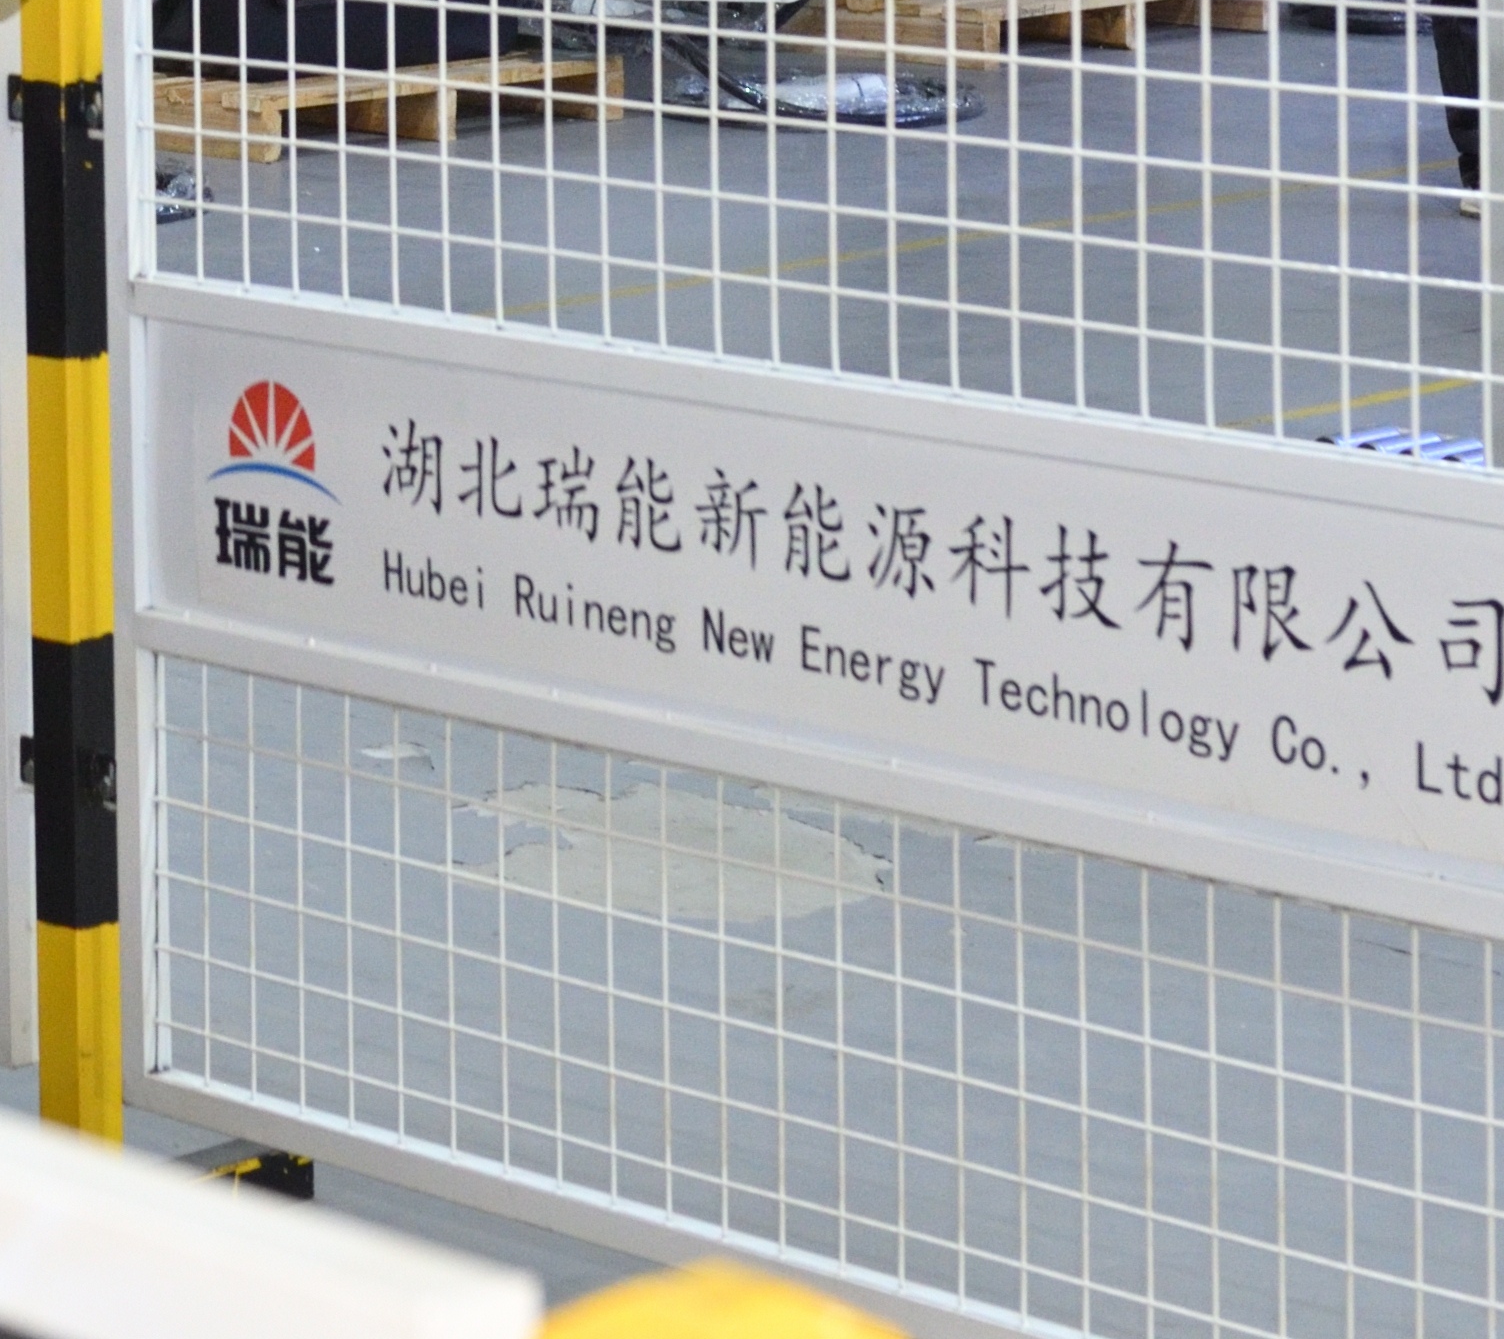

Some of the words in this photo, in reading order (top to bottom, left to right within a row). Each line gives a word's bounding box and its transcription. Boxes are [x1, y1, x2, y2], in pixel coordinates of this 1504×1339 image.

[213, 496, 335, 586] 瑞能
[382, 548, 485, 610] Hubei
[514, 573, 677, 654] Ruineng
[702, 606, 775, 664] New
[800, 624, 945, 705] Energy
[973, 658, 1239, 762] Technology
[1271, 715, 1370, 790] Co.,
